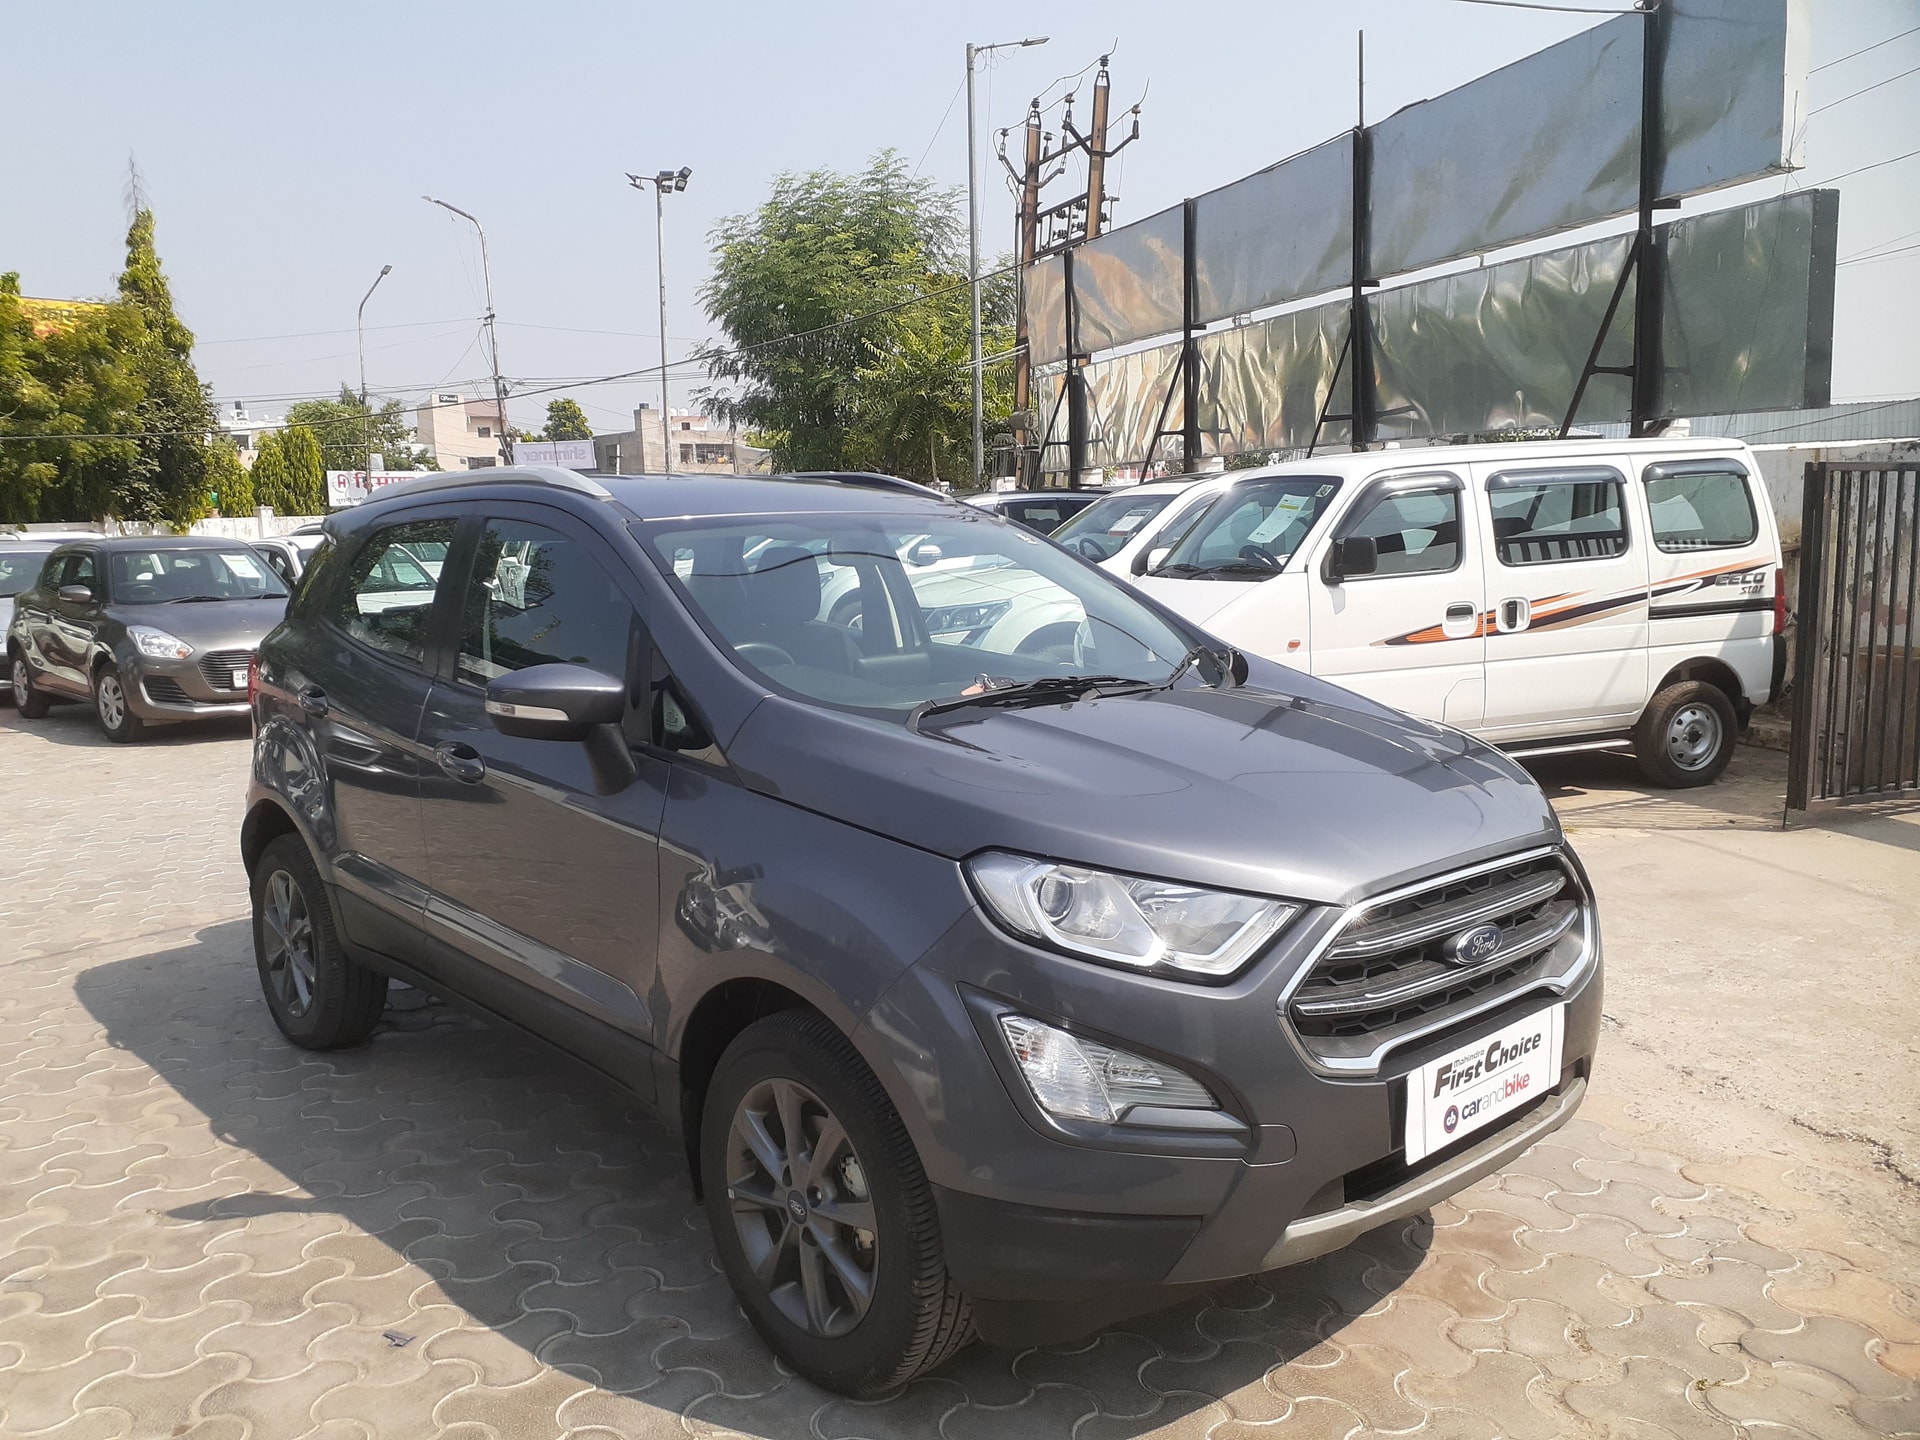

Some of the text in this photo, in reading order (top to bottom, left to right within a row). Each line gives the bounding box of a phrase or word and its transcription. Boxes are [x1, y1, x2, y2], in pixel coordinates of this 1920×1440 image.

[1715, 572, 1766, 586] EECO
[1472, 933, 1496, 956] Ford
[1433, 1033, 1541, 1099] First Choice
[1461, 1073, 1530, 1120] carandbike
